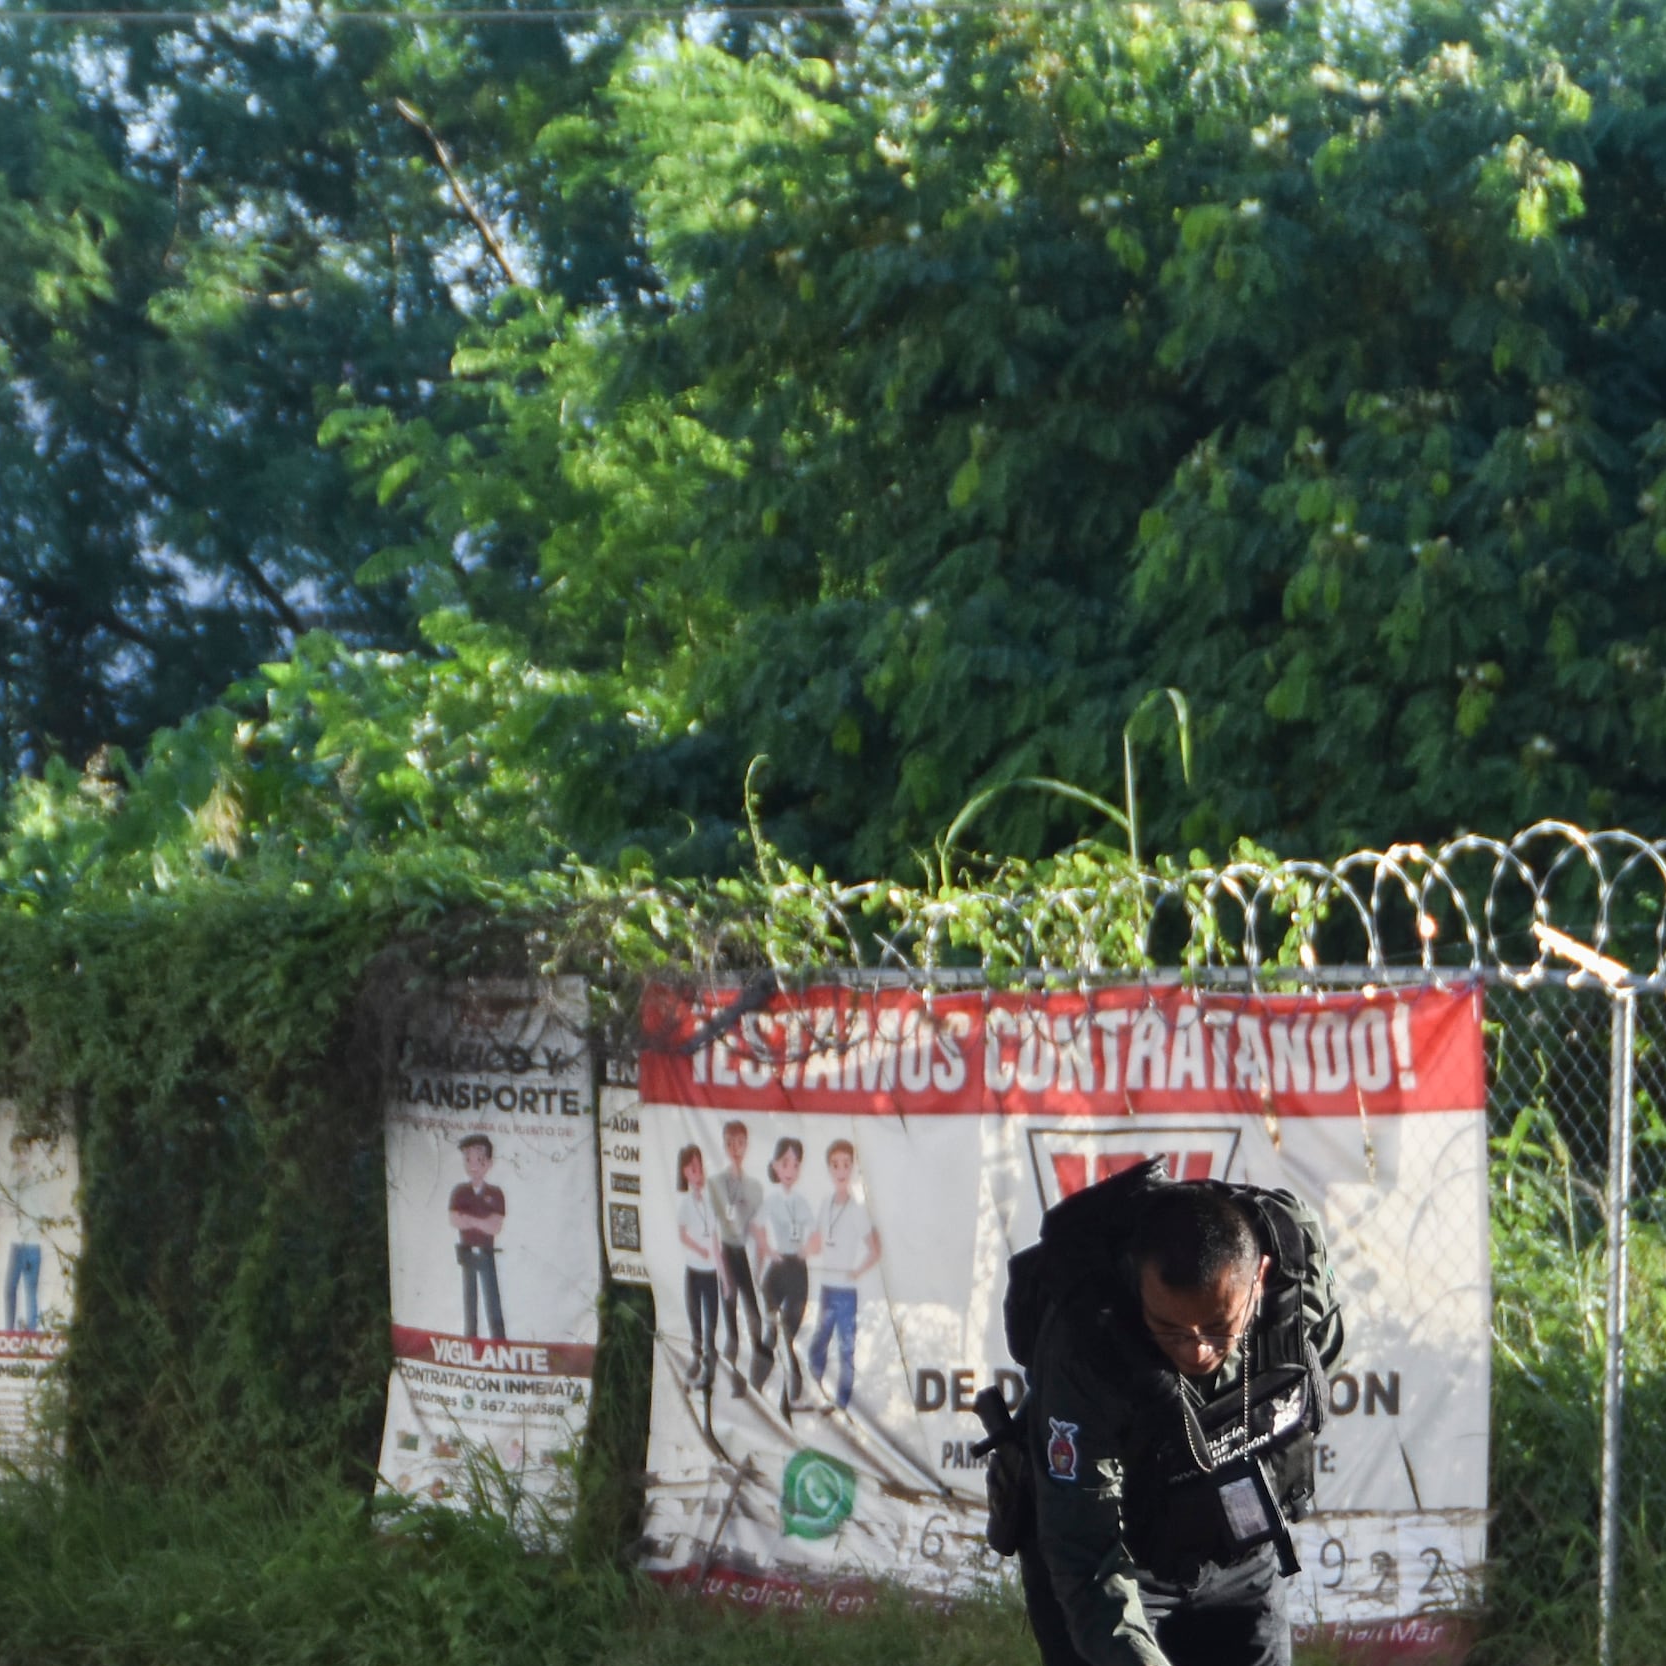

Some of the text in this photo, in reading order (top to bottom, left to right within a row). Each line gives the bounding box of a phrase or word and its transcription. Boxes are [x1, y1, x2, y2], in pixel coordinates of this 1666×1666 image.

[984, 1002, 1417, 1092] CONTRATANDO!
[395, 1078, 580, 1116] RANSPORTE
[430, 1335, 549, 1373] VIGILANTE
[915, 1368, 975, 1412] DE
[1205, 1424, 1245, 1450] OLICÍA
[1212, 1442, 1230, 1459] DE
